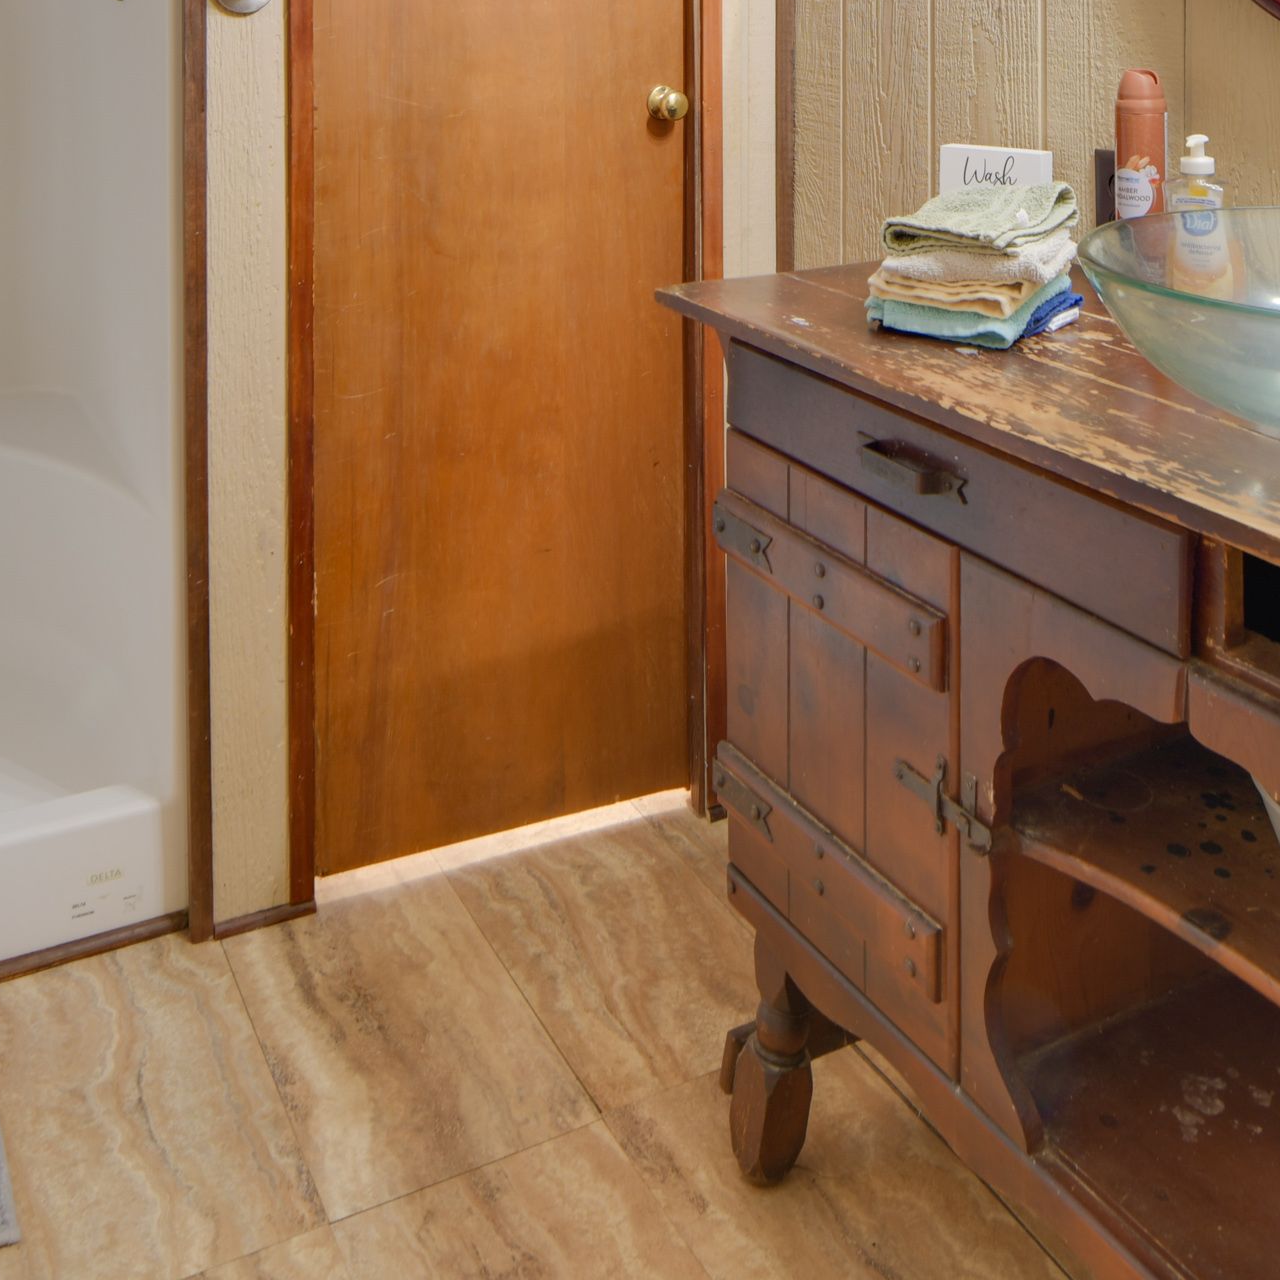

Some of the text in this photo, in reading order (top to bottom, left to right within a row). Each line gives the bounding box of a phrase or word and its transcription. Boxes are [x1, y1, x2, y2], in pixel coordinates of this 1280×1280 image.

[963, 155, 1018, 186] Wash
[1185, 210, 1214, 230] Dial
[90, 868, 122, 884] DELTA
